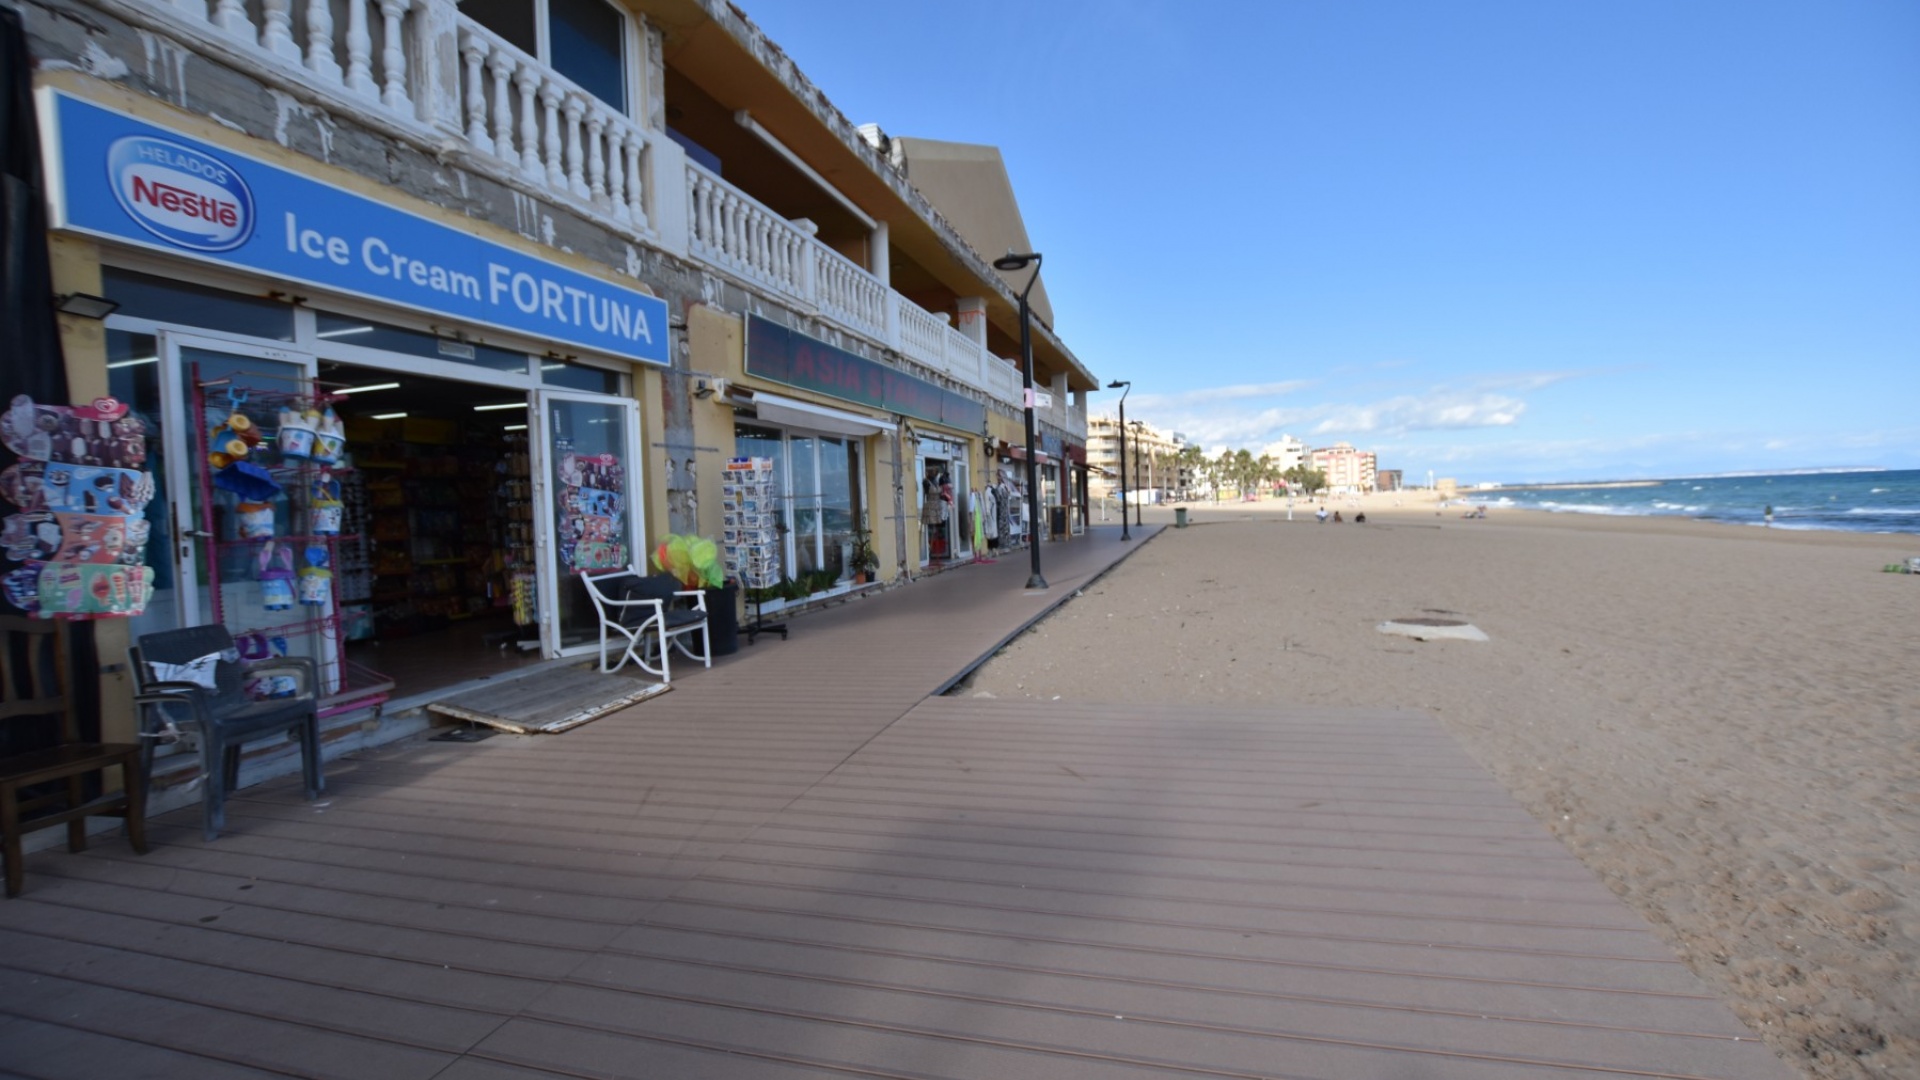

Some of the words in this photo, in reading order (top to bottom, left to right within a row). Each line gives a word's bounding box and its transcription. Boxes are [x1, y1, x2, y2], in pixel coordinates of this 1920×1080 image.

[138, 145, 227, 184] HELADOS
[285, 211, 350, 266] Ice
[361, 236, 481, 301] Cream
[488, 262, 652, 345] FORTUNA
[796, 344, 862, 391] ASIA
